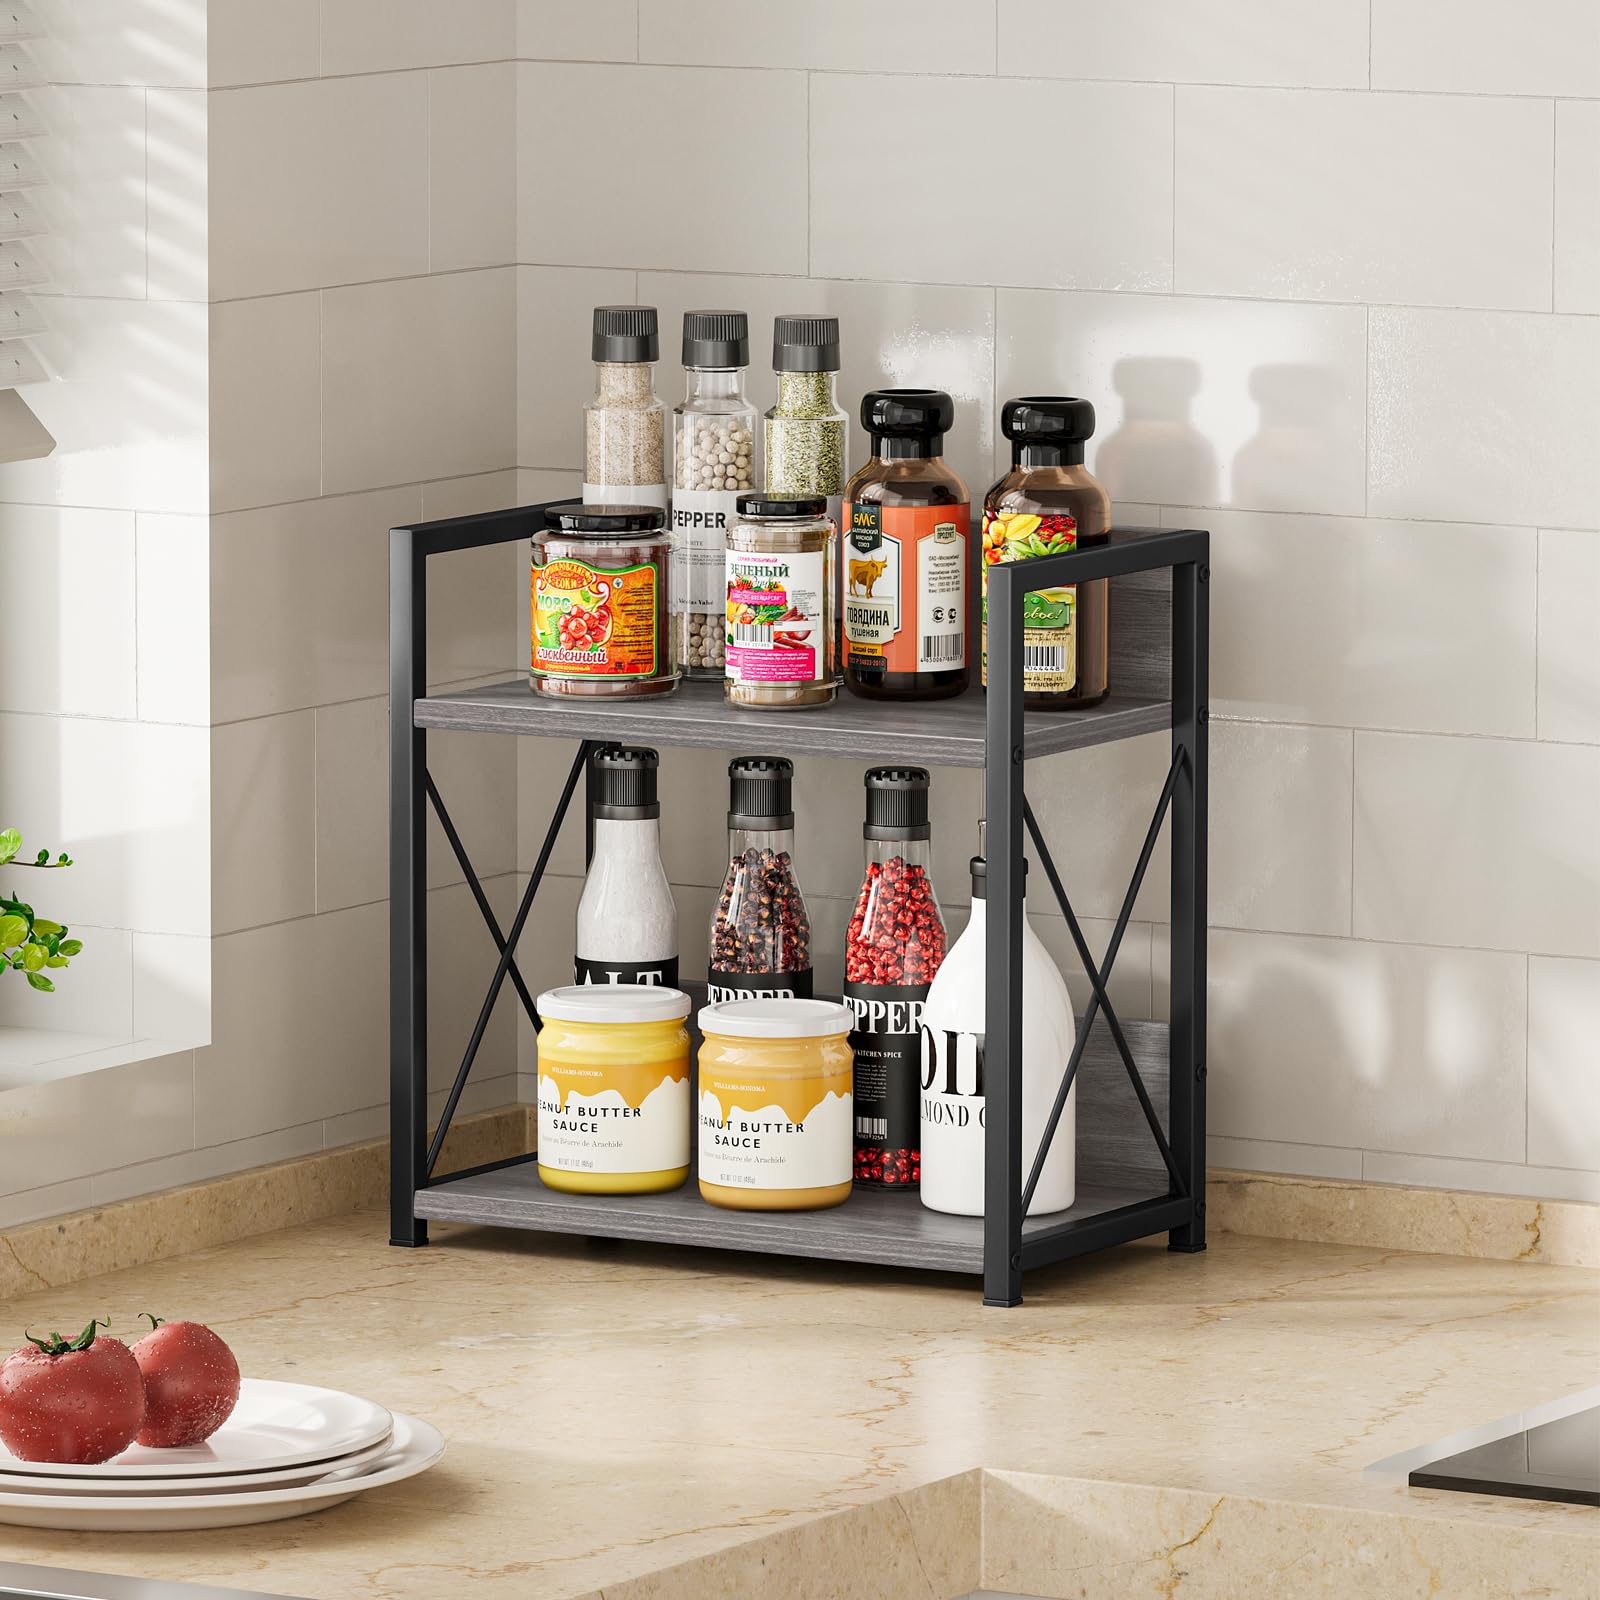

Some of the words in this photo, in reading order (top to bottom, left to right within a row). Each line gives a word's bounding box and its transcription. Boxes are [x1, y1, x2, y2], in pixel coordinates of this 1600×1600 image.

[674, 509, 726, 529] PEPPER
[731, 563, 790, 578] ЗЕЛЕНЫЙ
[847, 606, 890, 627] ГОВЯДИНА
[851, 627, 880, 638] тушеная
[883, 1051, 902, 1059] SPICE
[577, 1107, 641, 1118] BUTTER
[553, 1119, 598, 1133] SAUCE
[740, 1122, 804, 1133] BUTTER
[714, 1134, 761, 1149] SAUCE
